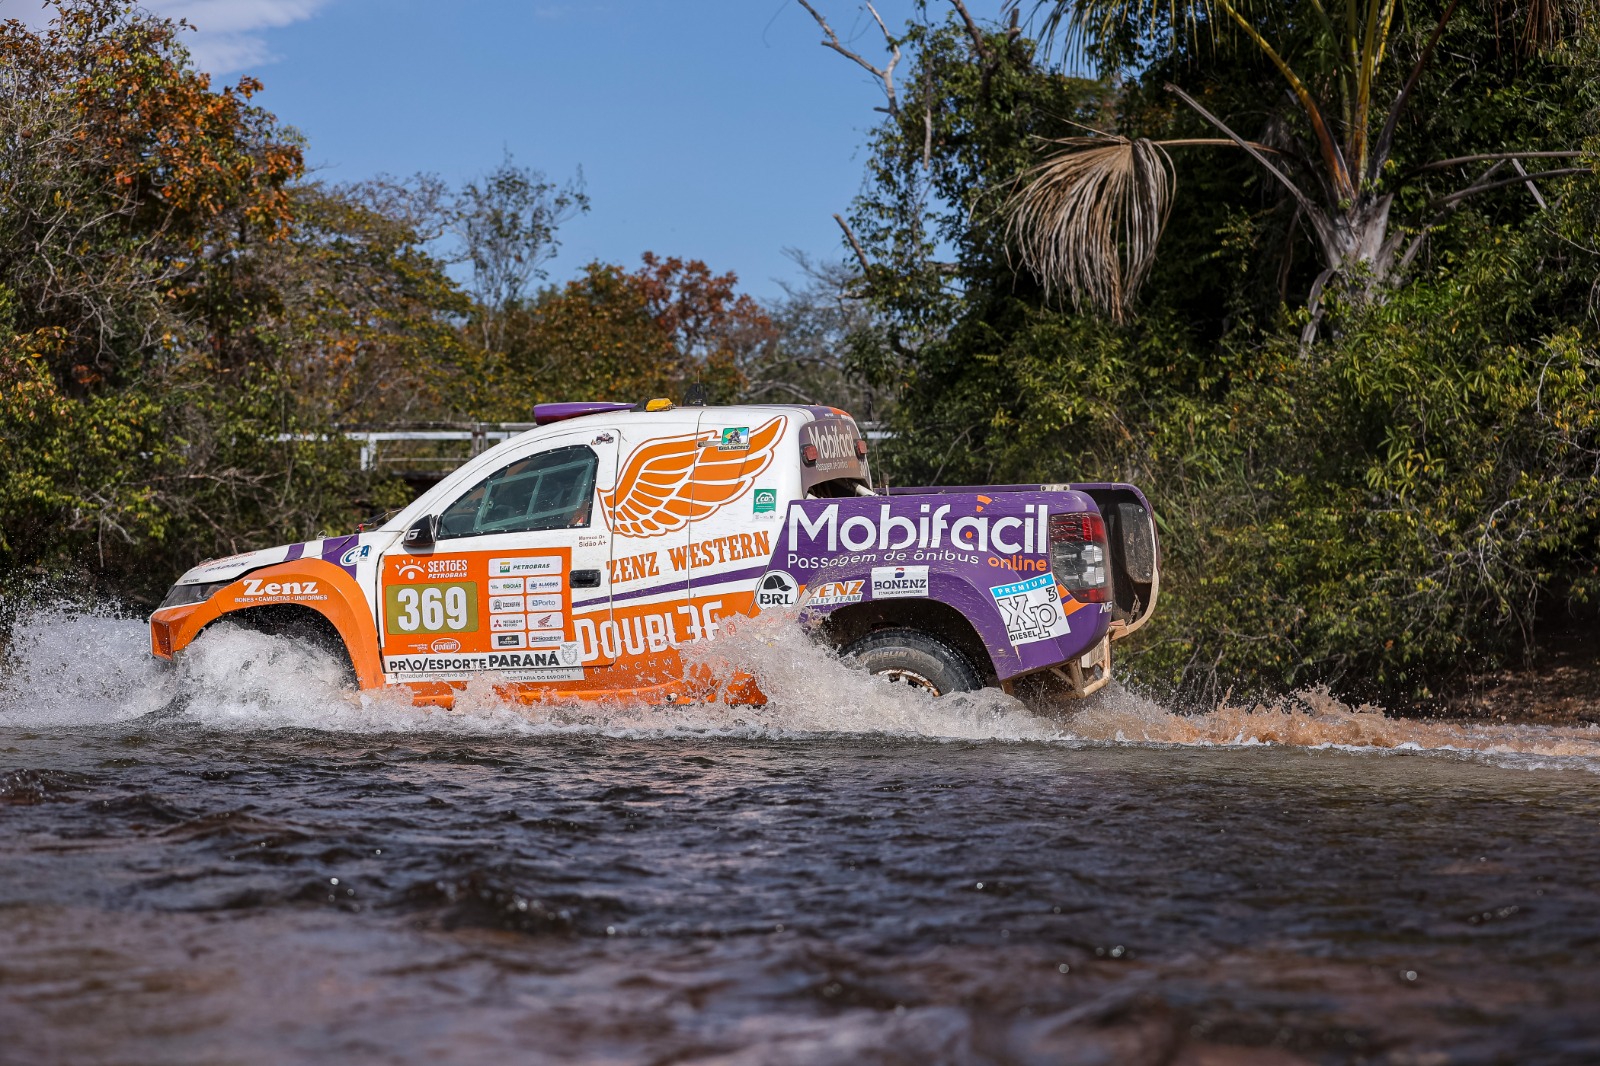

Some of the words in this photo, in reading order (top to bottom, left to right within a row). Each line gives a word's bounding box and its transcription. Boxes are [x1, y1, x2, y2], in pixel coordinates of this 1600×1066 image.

[606, 551, 660, 584] ZENZ
[668, 530, 771, 572] WESTERN
[787, 553, 876, 568] Passagem
[884, 552, 907, 562] de
[914, 550, 980, 565] ônibus
[988, 555, 1047, 572] online
[243, 579, 319, 596] Zenz
[874, 579, 927, 590] BONENZ
[997, 577, 1048, 595] PREMIUM
[760, 593, 794, 605] BRL
[808, 597, 830, 605] ALLY
[834, 595, 861, 603] TEAM
[397, 586, 468, 631] 369
[1010, 630, 1038, 641] DIESEL
[434, 641, 457, 651] podium
[488, 651, 560, 668] PARANÁ
